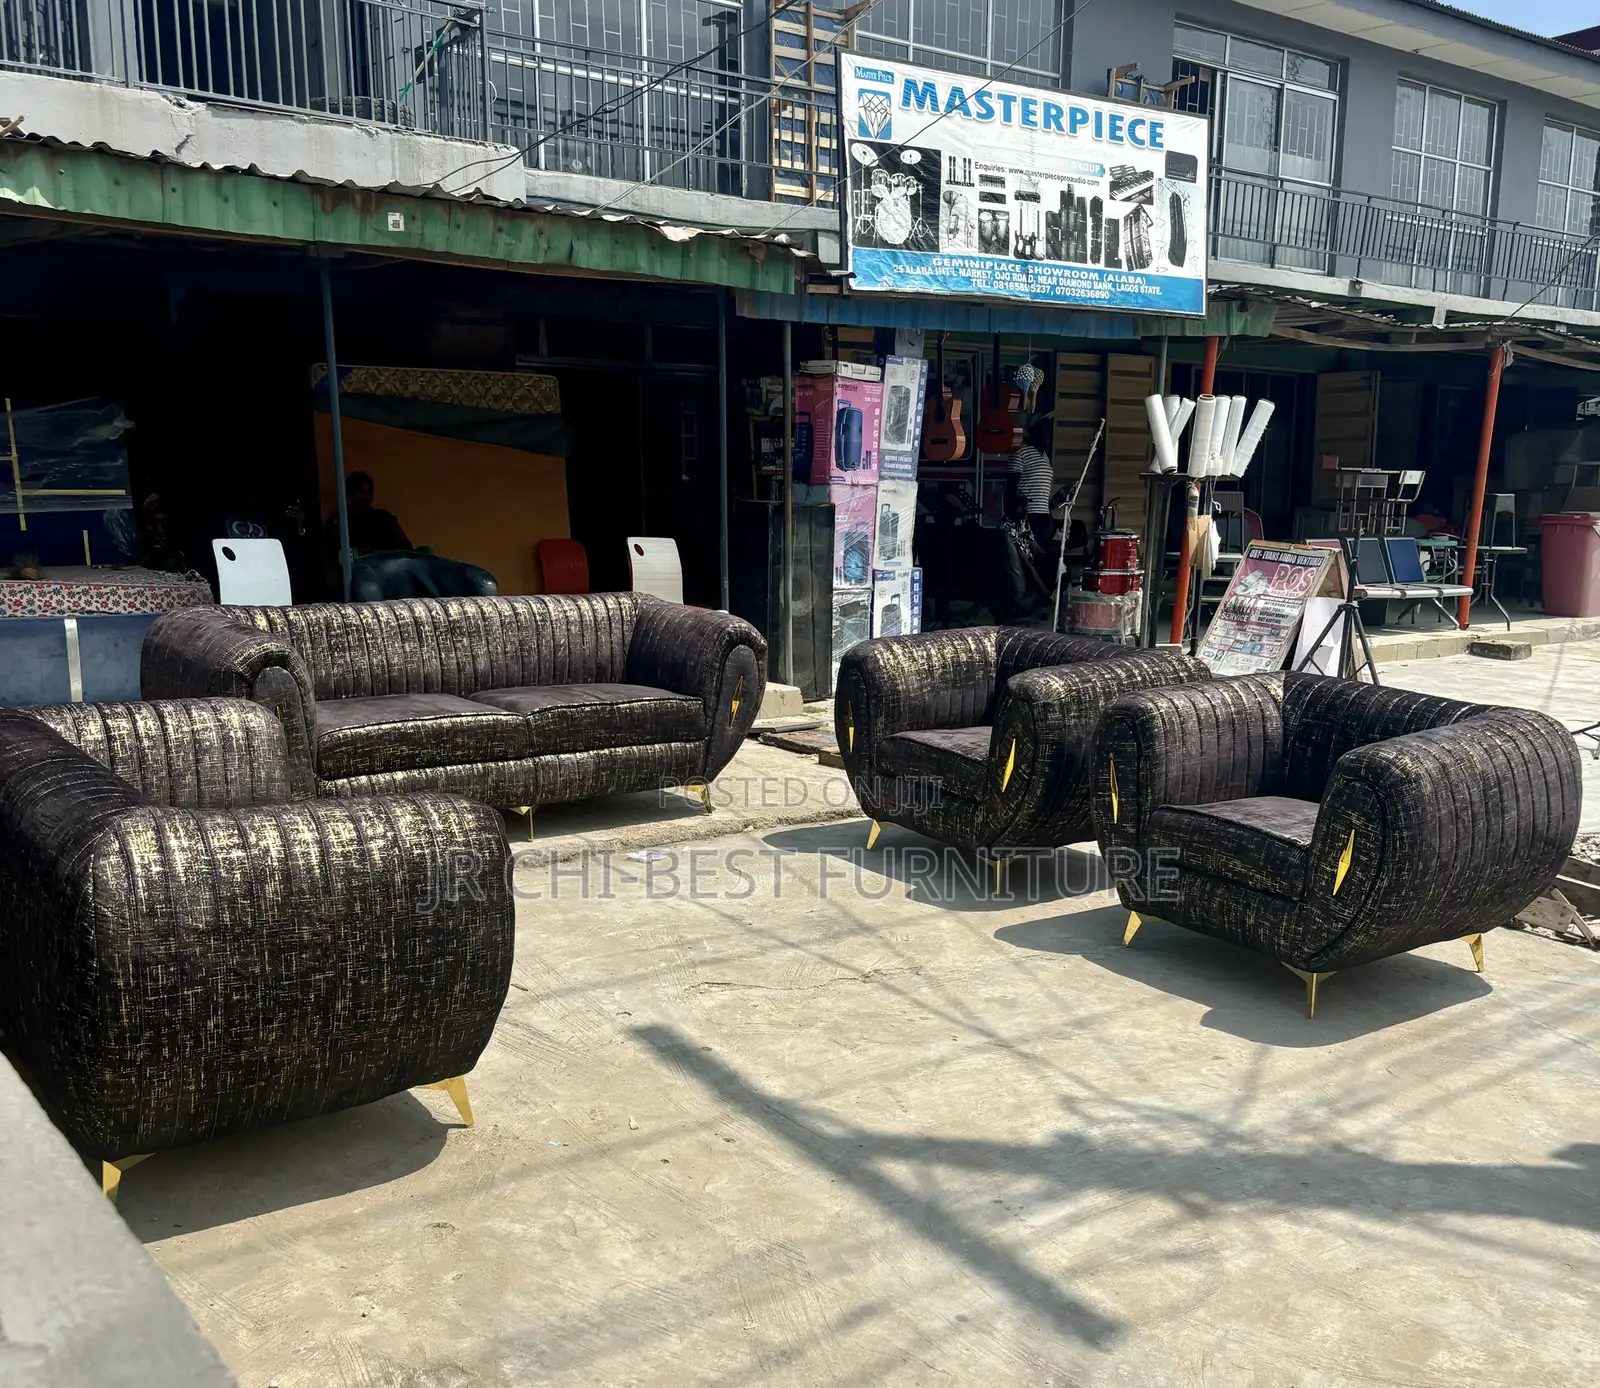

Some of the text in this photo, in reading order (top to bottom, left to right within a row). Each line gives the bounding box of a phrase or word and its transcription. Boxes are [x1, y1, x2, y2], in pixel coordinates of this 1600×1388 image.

[901, 77, 1165, 149] MASTERPIECE
[974, 162, 1007, 173] Enquiries:
[906, 265, 933, 275] ALABA
[959, 268, 993, 280] MARKET,
[994, 272, 1011, 281] OJO
[1012, 273, 1036, 284] ROAD,
[1038, 275, 1057, 285] NEAR
[1059, 277, 1091, 289] DIAMOND
[1094, 280, 1115, 292] BANK,
[1116, 282, 1138, 293] LAGOS
[1140, 284, 1162, 295] STATE.
[932, 258, 1146, 285] GEMINIPLACE SHOWROOM (ALABA)
[971, 278, 991, 288] TEL:
[1055, 286, 1110, 299] 07032636890
[1262, 551, 1279, 561] EVANS
[1280, 553, 1296, 563] AUDIO
[1270, 563, 1316, 593] POS
[1221, 612, 1249, 622] SERVICE
